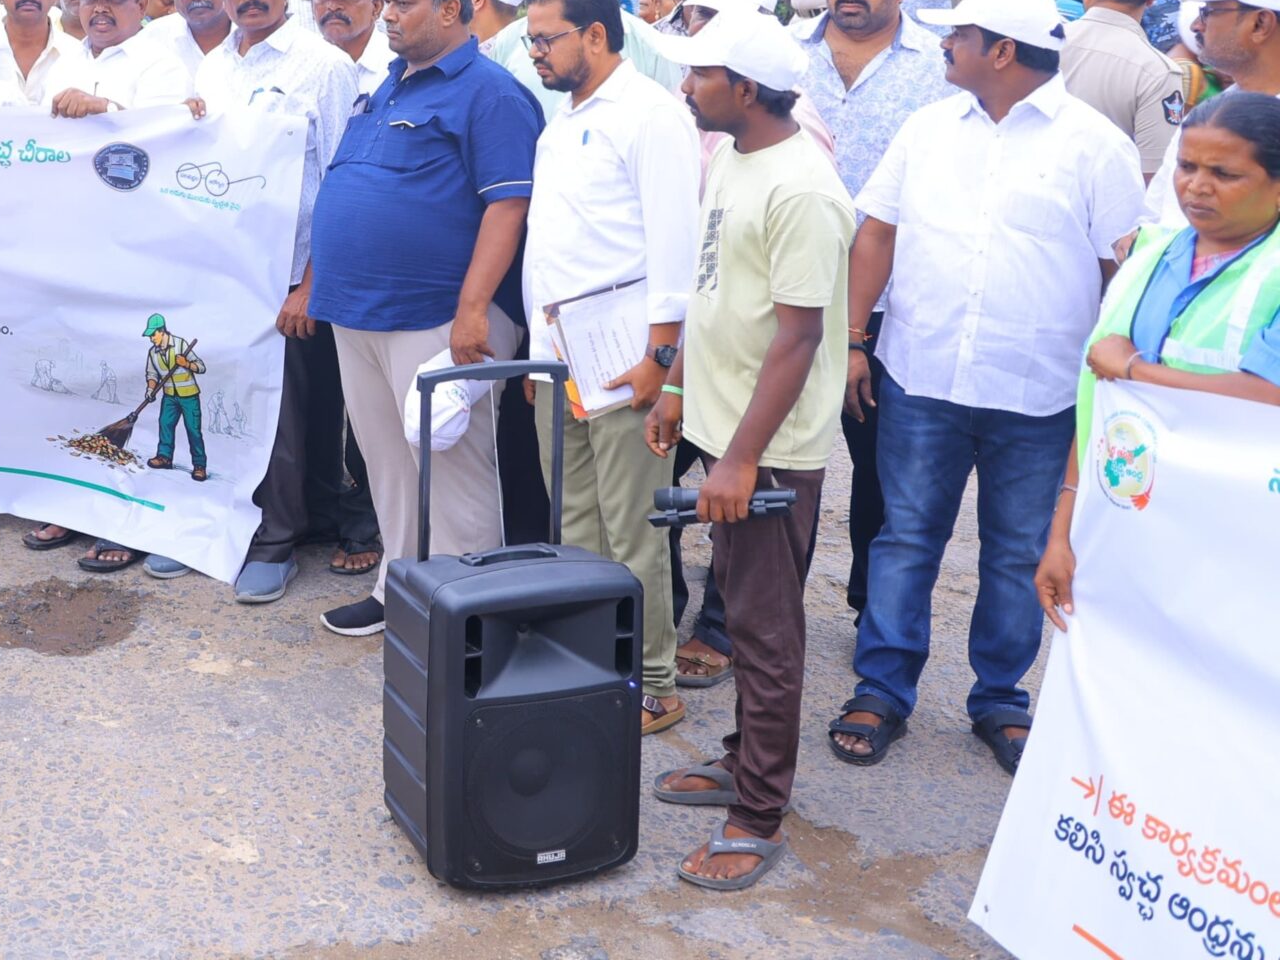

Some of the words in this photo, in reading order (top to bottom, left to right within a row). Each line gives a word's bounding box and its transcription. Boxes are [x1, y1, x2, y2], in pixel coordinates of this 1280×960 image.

[17, 138, 72, 163] చీరాల
[1107, 790, 1136, 826] ఈ
[1054, 814, 1106, 865] కలిసి
